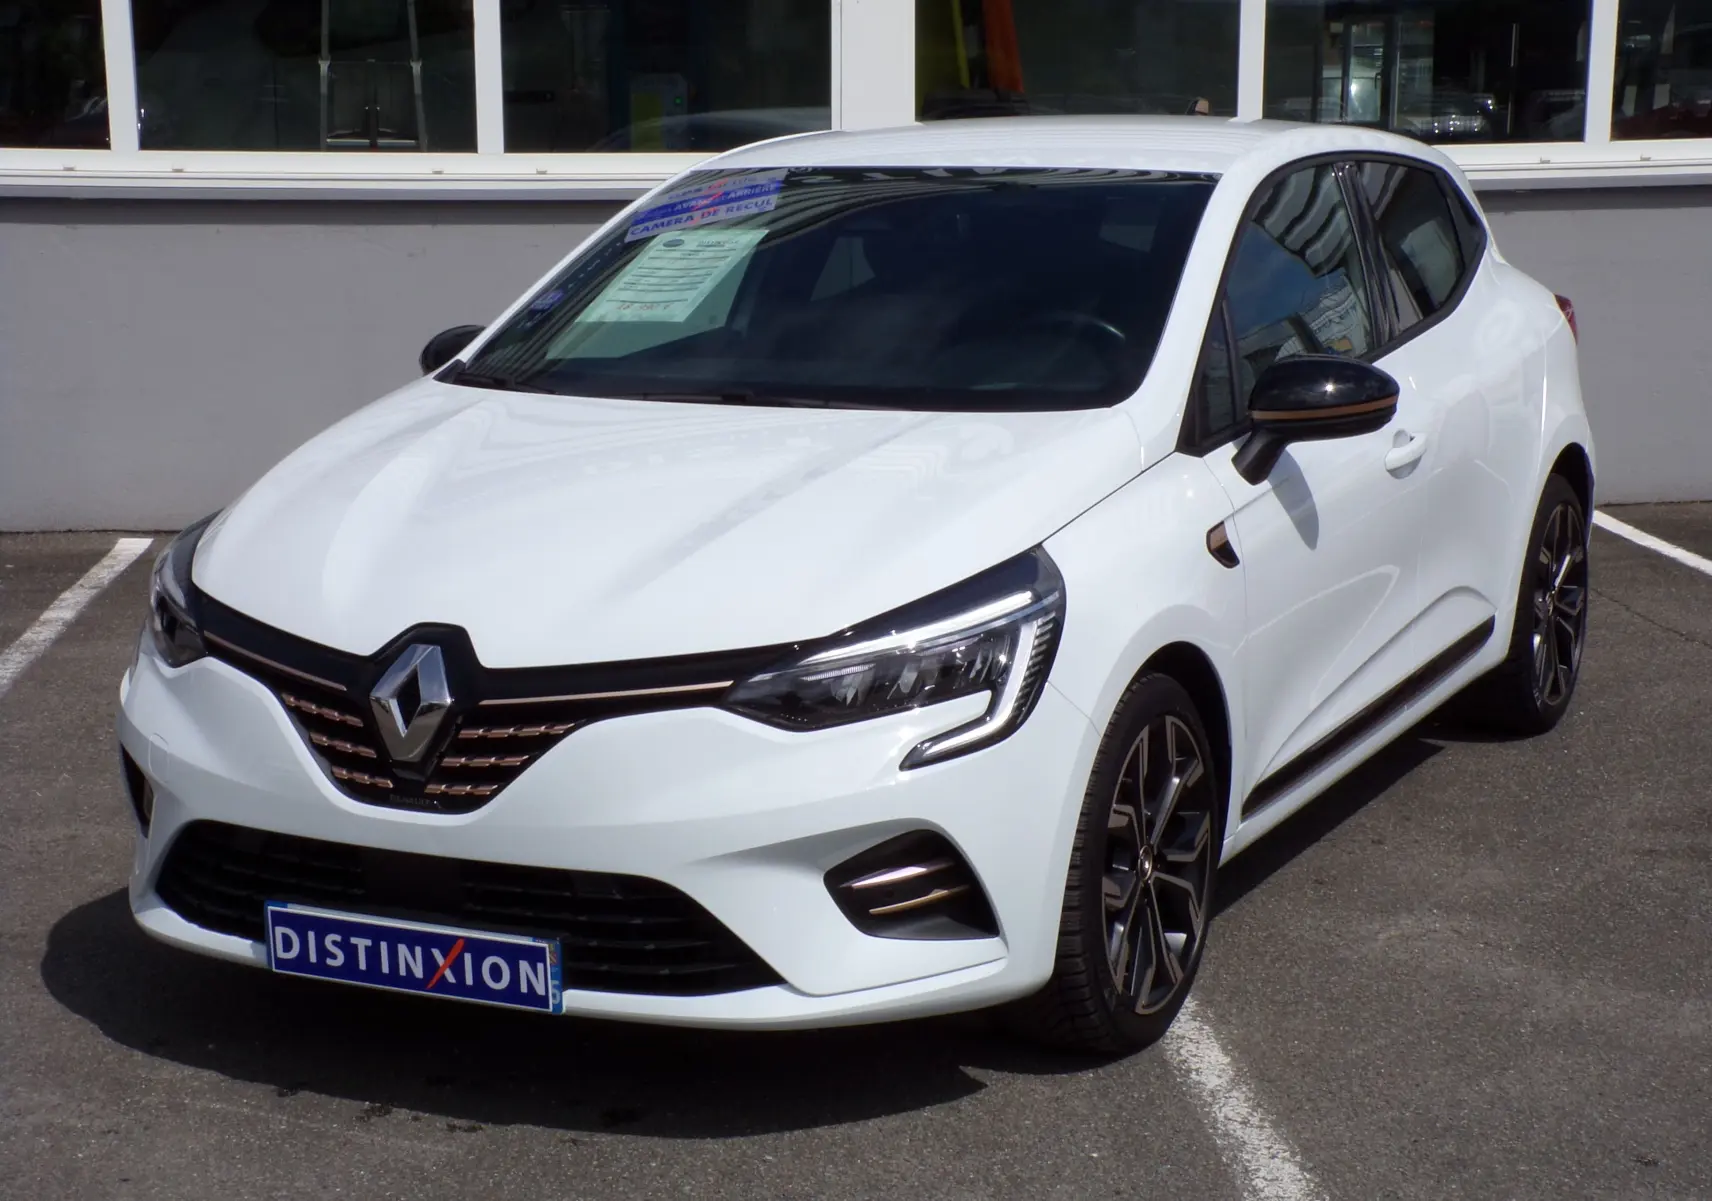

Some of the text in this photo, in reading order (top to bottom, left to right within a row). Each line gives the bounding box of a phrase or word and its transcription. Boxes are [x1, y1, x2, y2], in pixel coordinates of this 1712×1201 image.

[629, 214, 695, 237] CAMERA
[701, 208, 720, 219] DE
[725, 198, 773, 217] RECUL
[273, 926, 546, 996] DISTINXION
